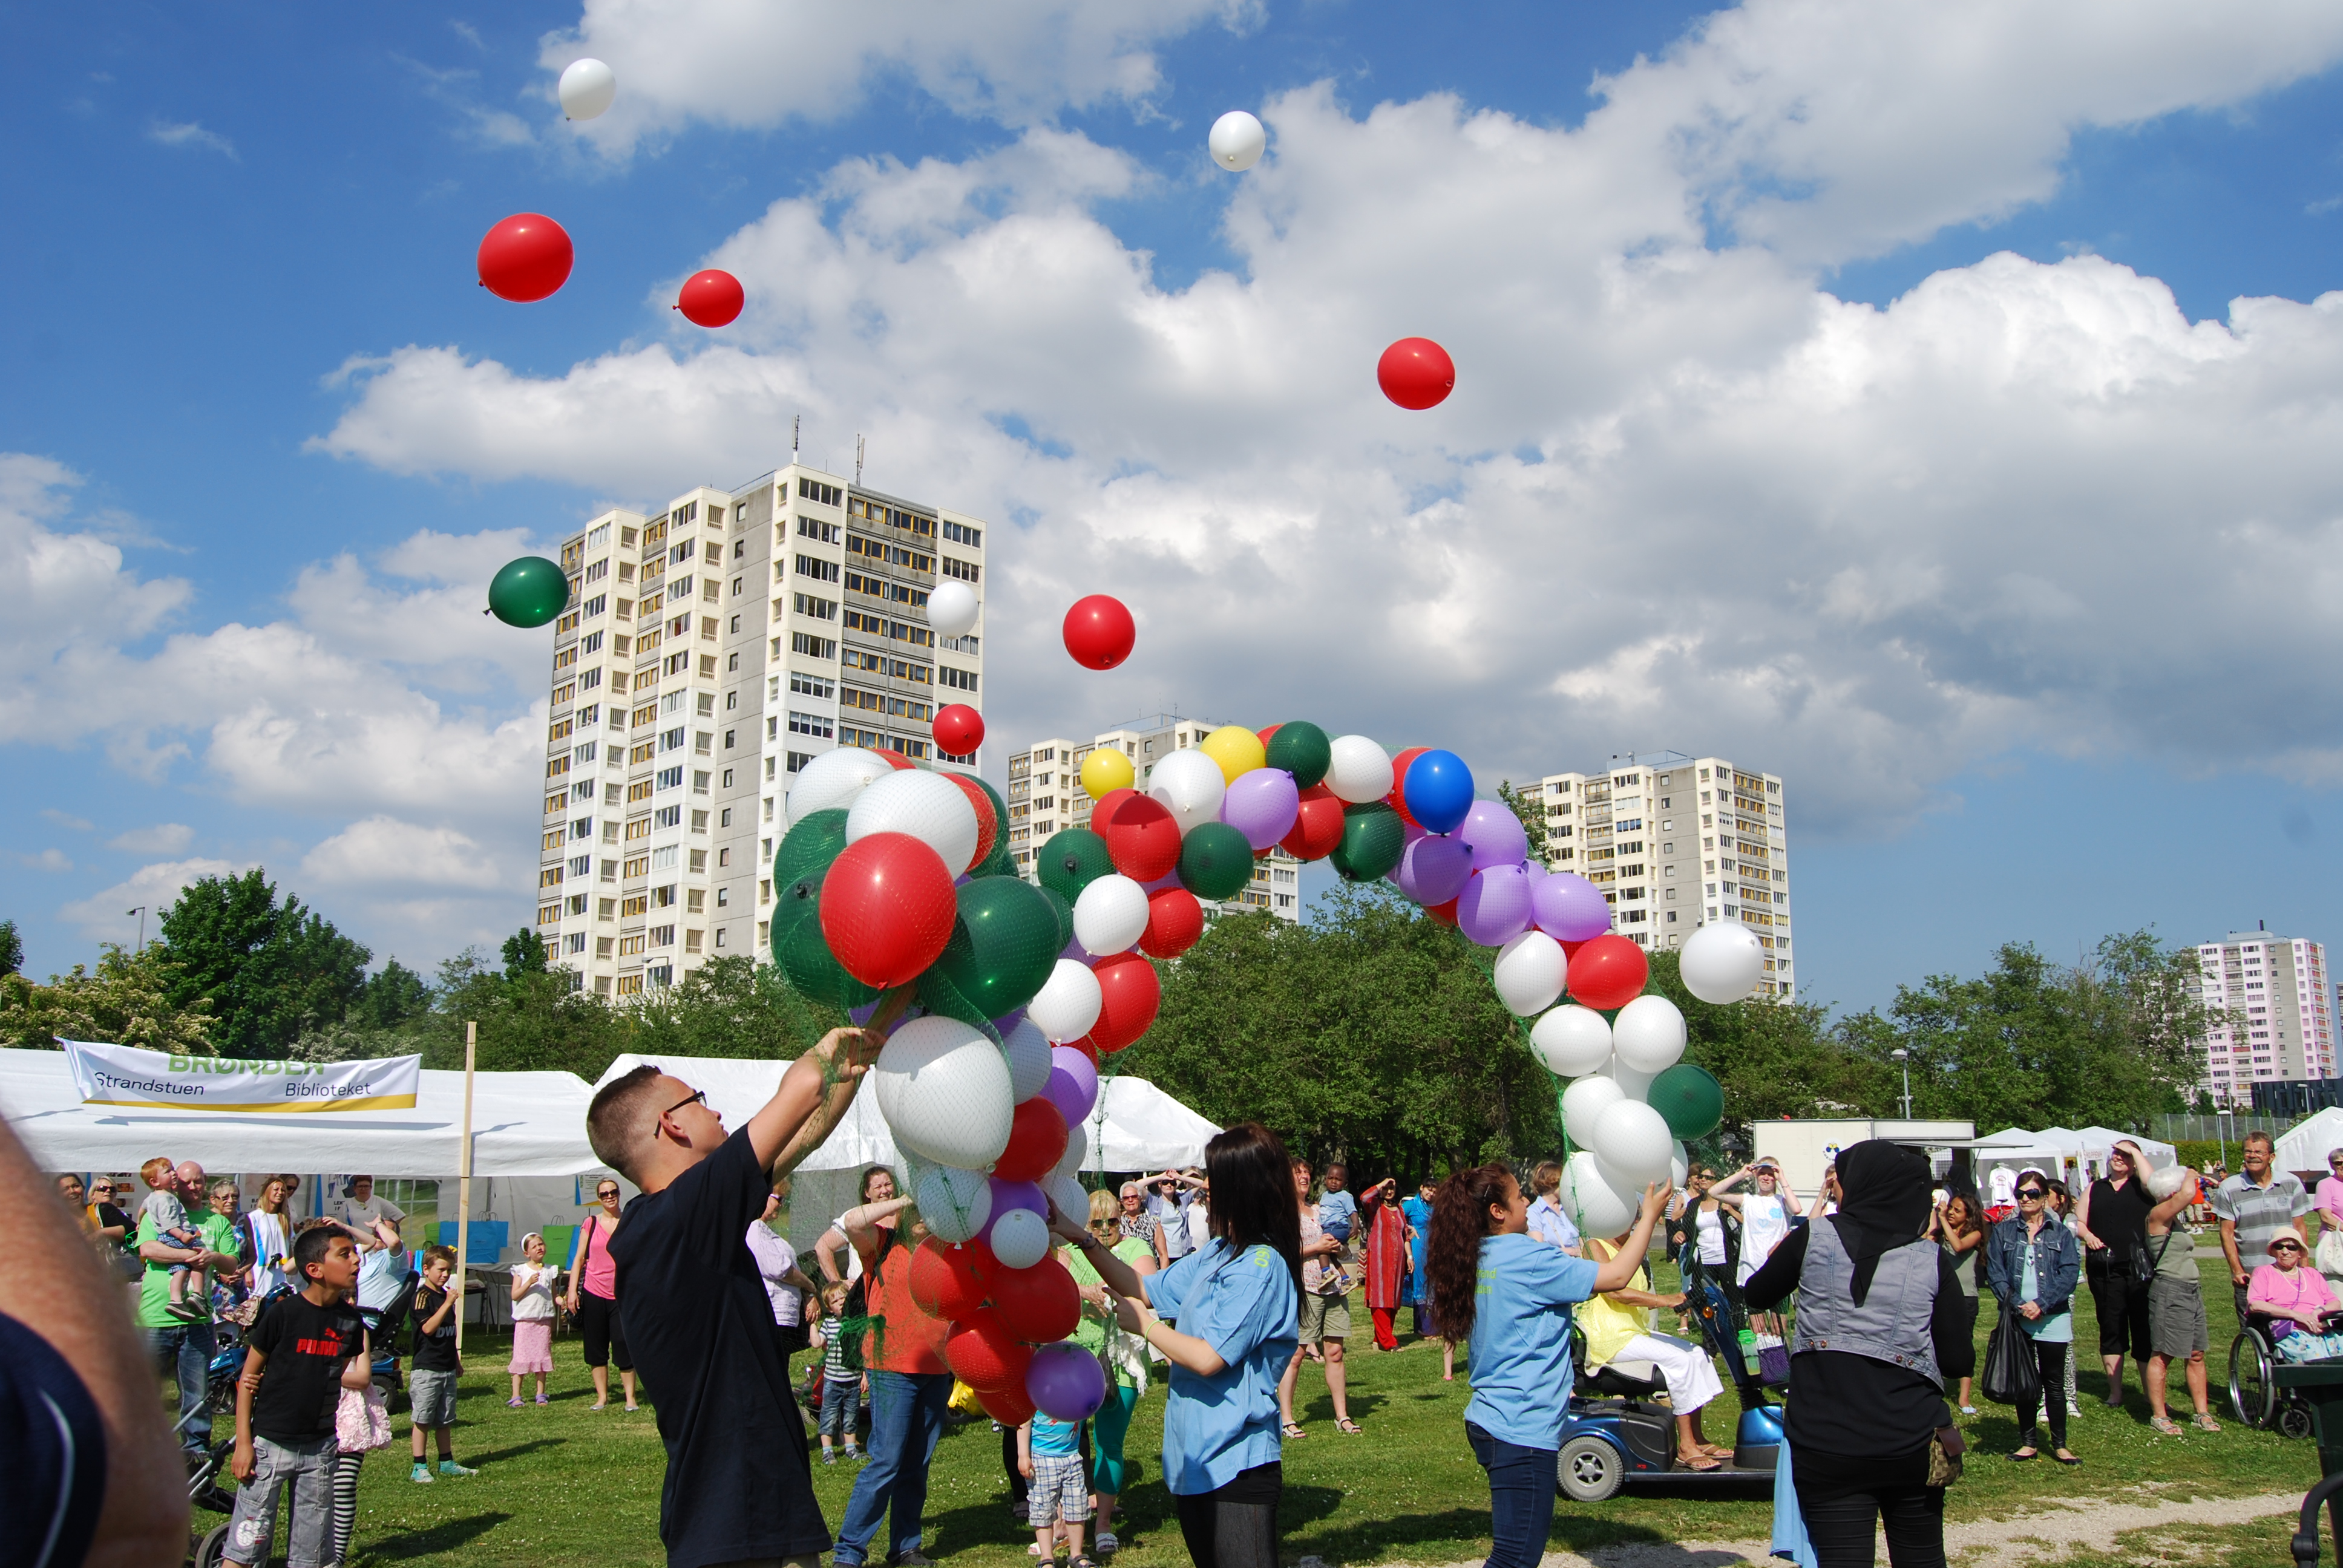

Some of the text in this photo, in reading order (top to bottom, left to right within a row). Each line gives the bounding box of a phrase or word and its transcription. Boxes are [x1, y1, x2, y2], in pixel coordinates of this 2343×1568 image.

[94, 1072, 205, 1095] Strandstuen
[286, 1082, 371, 1097] Biblioteket
[296, 1339, 338, 1356] PUMA
